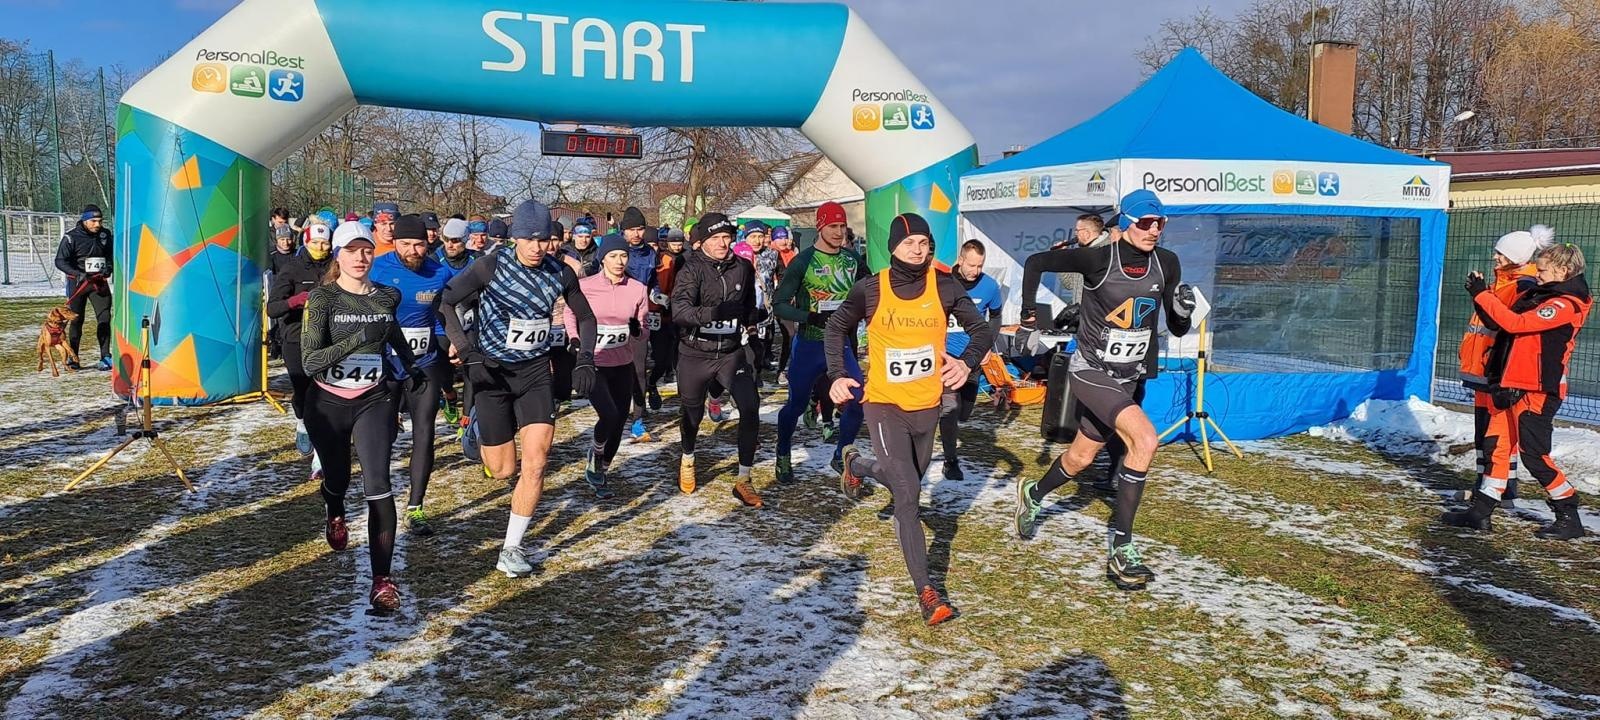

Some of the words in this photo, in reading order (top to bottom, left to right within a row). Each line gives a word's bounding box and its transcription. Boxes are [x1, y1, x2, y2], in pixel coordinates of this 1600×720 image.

[482, 10, 706, 83] START
[195, 48, 305, 70] PersonalBest
[852, 88, 930, 104] PersonalBest
[1143, 171, 1266, 192] PersonalBest
[966, 180, 1017, 201] PersonalBest
[1402, 185, 1431, 197] MITKO
[896, 316, 940, 328] VISAGE
[511, 329, 547, 345] 740
[596, 332, 627, 345] 728
[1109, 341, 1147, 357] 672
[331, 364, 379, 383] 644
[889, 358, 933, 377] 679
